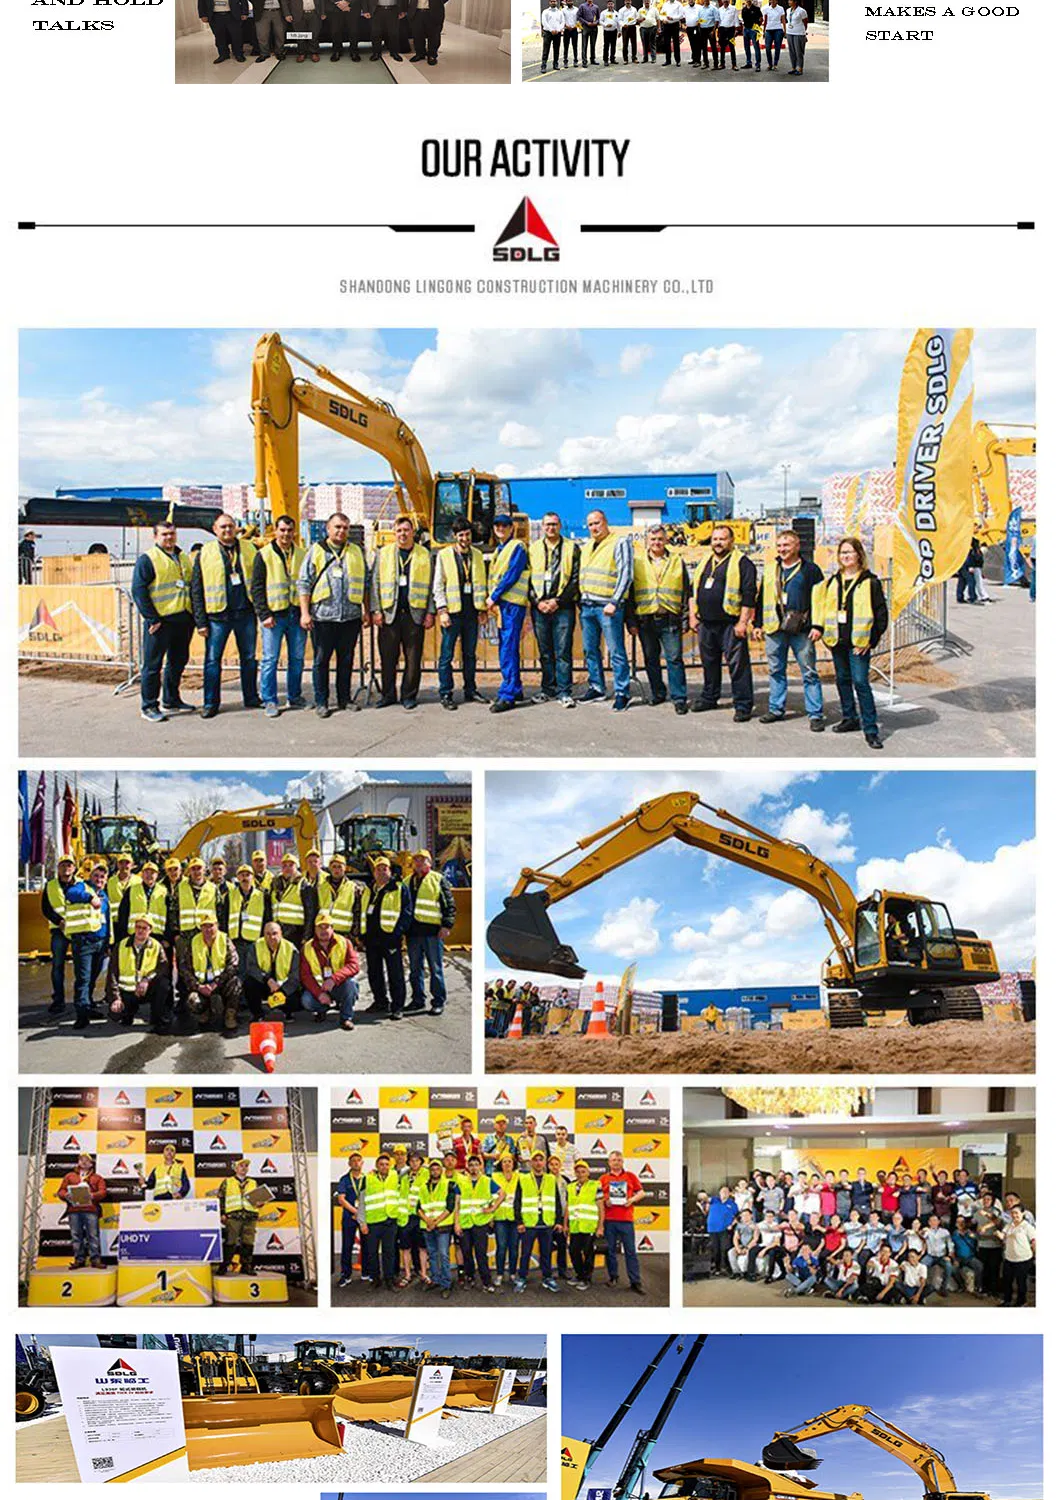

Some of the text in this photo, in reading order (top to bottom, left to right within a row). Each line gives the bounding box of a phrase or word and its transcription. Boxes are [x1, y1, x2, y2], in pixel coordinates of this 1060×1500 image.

[925, 334, 948, 415] SDLG
[329, 399, 369, 428] SDLG
[912, 421, 945, 532] DRIVER
[242, 819, 276, 828] SDLG
[718, 833, 770, 860] SDLG
[61, 1281, 73, 1297] 2
[156, 1269, 168, 1291] 1
[249, 1283, 260, 1298] 3
[95, 1377, 150, 1385] 山东临工
[870, 1427, 905, 1449] SDLG
